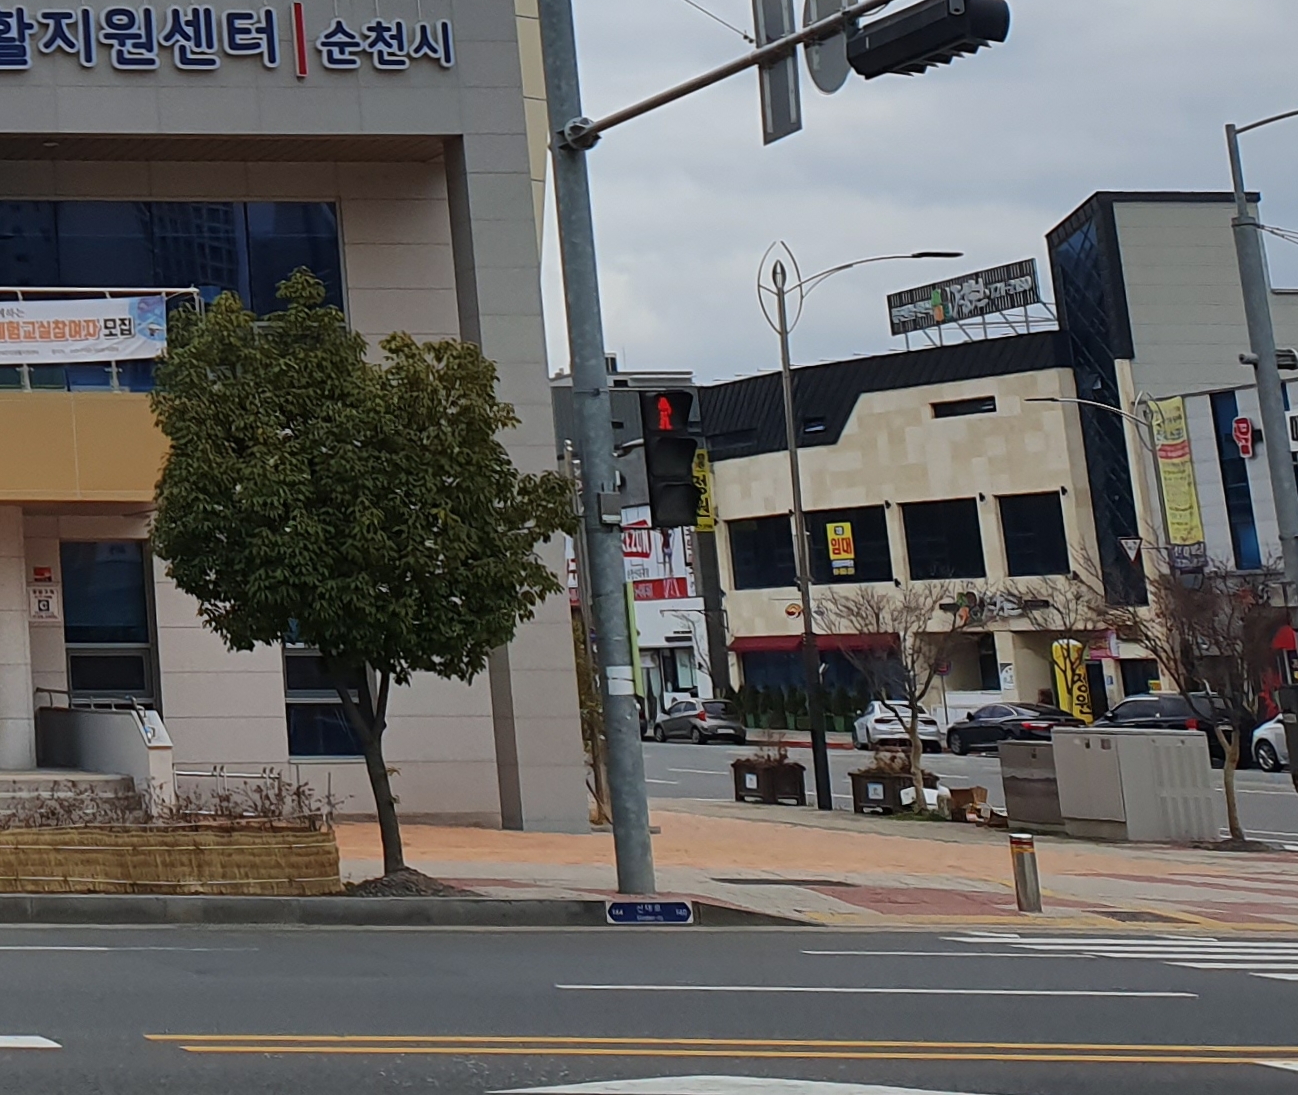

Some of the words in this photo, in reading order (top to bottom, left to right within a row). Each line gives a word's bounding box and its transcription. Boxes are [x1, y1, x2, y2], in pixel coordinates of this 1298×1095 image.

[316, 17, 454, 69] 순천시
[103, 317, 134, 338] 모집
[830, 537, 852, 555] 임대
